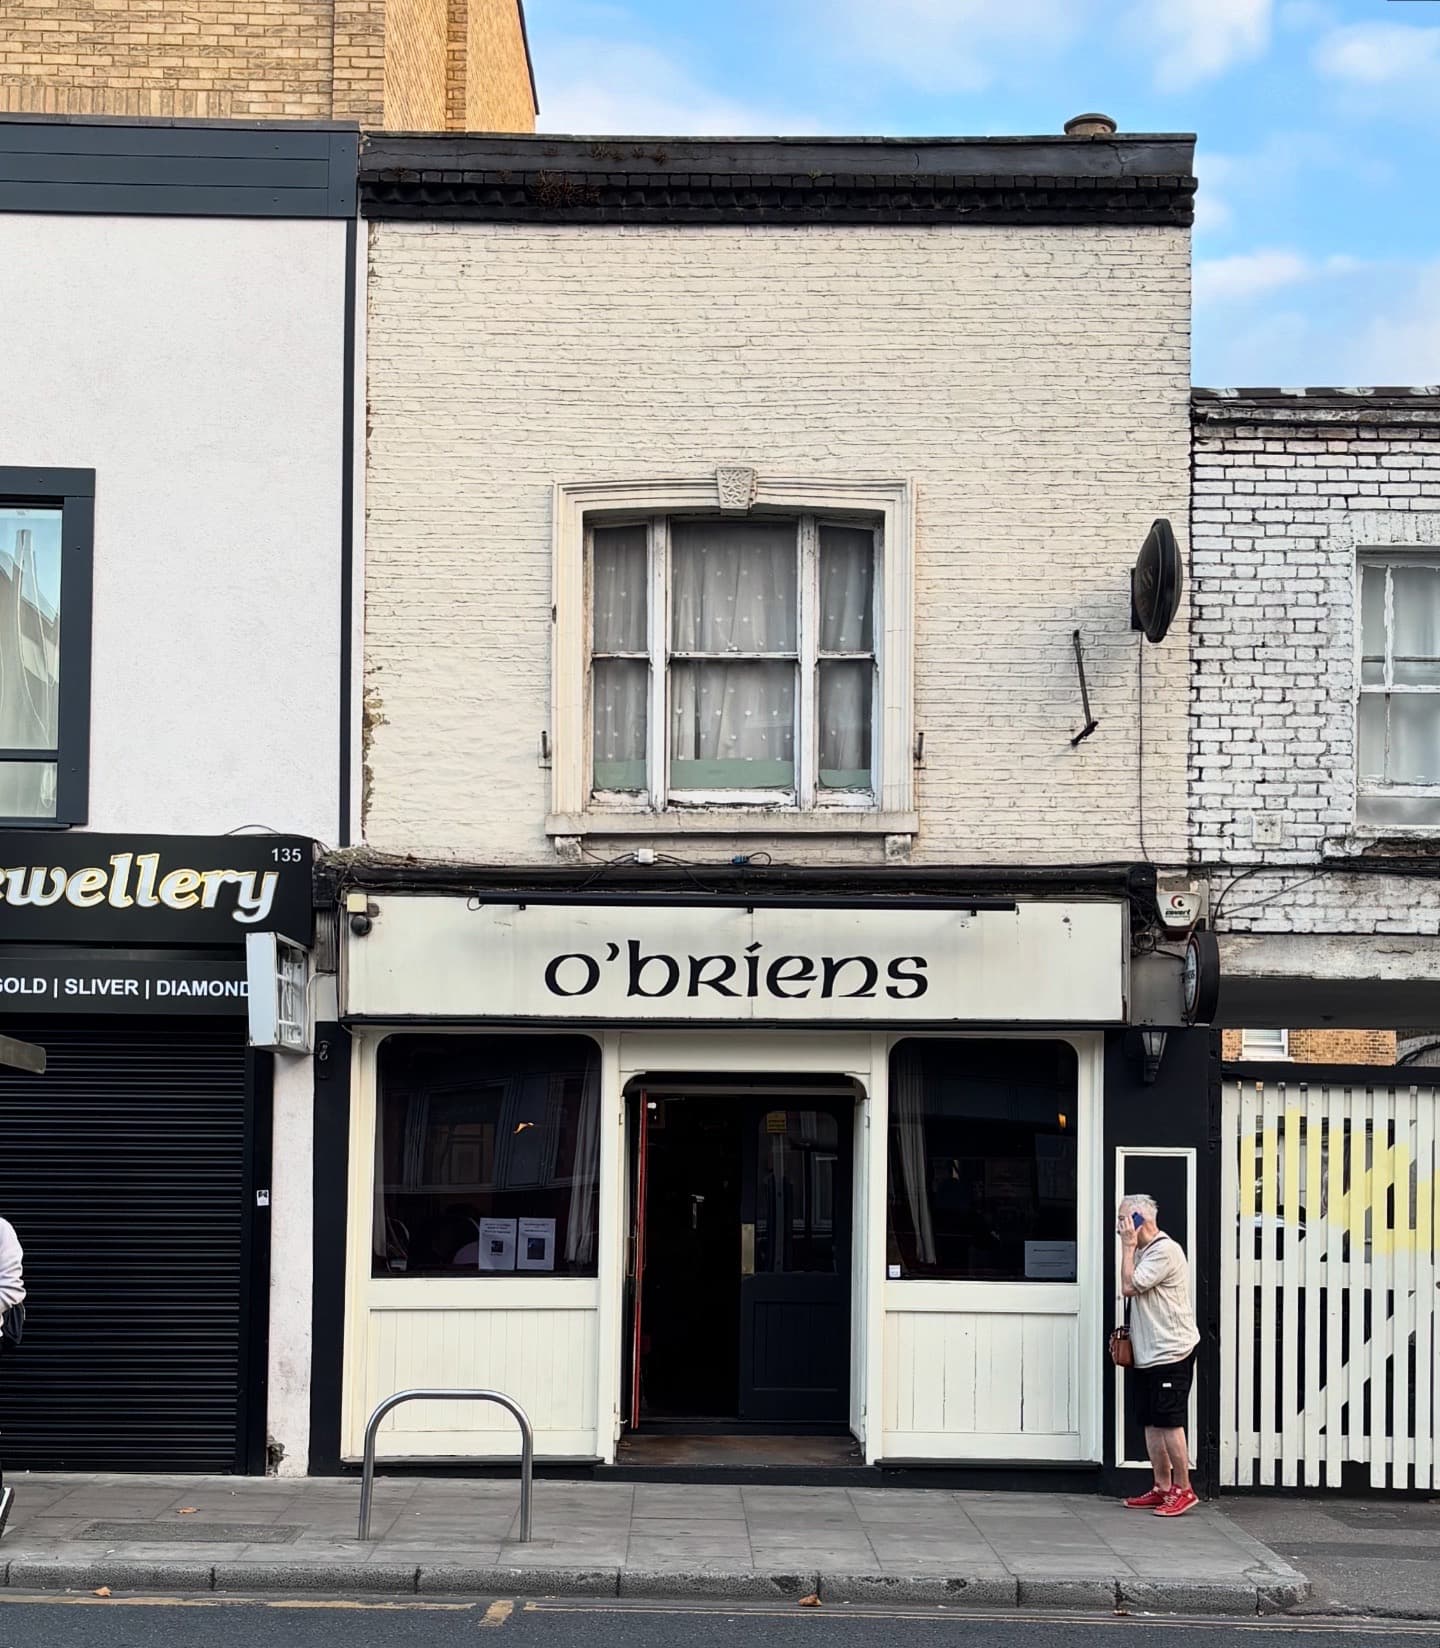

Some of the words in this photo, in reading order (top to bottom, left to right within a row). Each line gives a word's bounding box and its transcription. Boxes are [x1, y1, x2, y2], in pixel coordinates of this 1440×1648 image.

[272, 848, 301, 862] 135
[0, 853, 280, 923] wellery
[0, 977, 47, 994] OLD
[65, 978, 139, 995] SLIVER
